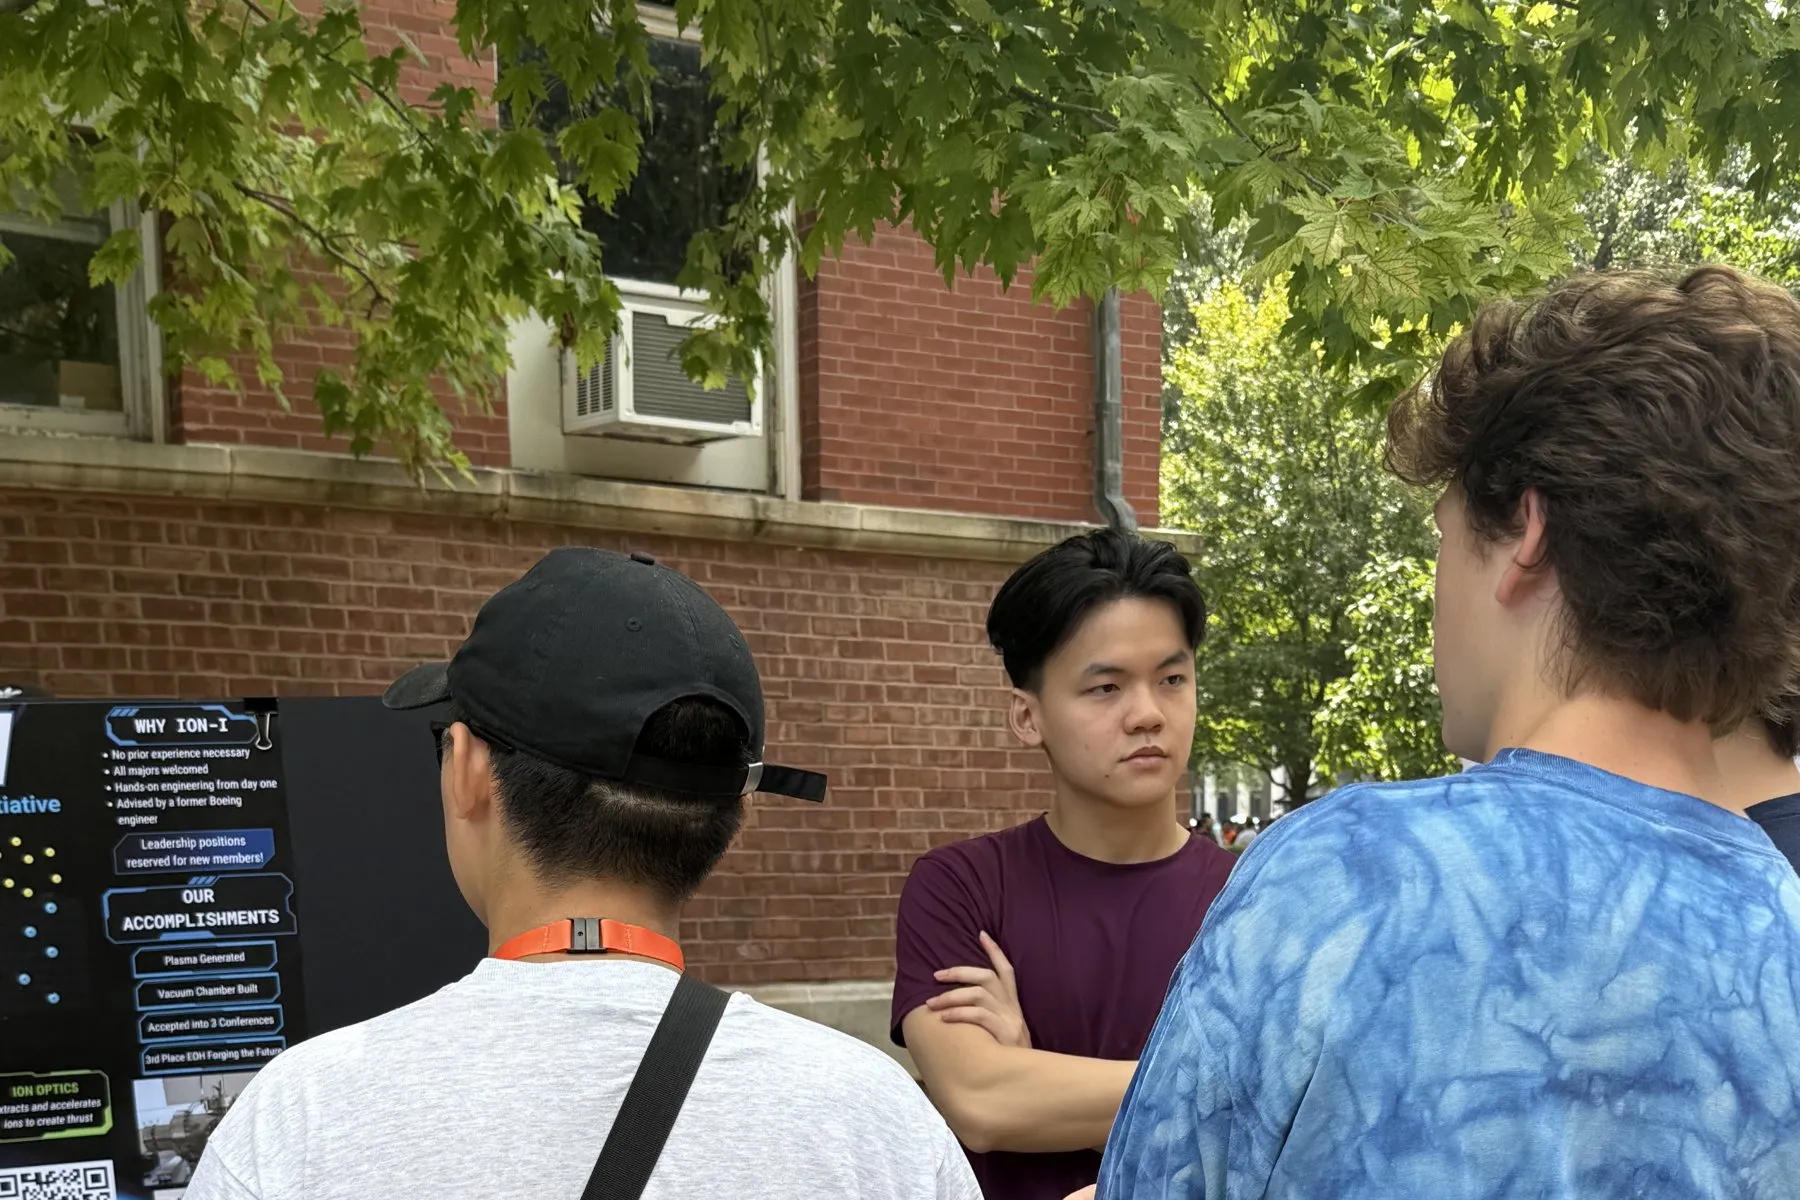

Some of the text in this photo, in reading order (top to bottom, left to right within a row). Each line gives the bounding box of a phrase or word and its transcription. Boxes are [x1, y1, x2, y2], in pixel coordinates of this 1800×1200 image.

[134, 717, 229, 733] WHY ION-I
[112, 748, 251, 762] No prior experience necessary
[113, 764, 209, 778] All majors welcomed
[114, 778, 278, 793] Hands-on engineering from day one
[116, 795, 243, 809] Advised by a former Boeing
[117, 815, 159, 827] engineer
[141, 836, 247, 850] Leadership positions
[126, 852, 264, 868] reserved for new members!
[181, 888, 215, 904] OUR
[122, 909, 280, 931] ACCOMPLISHMENTS
[163, 952, 246, 966] Plasma Generated
[157, 983, 258, 999] Vacuum Chamber Built
[148, 1016, 275, 1033] Accepted into 3 Conferences
[161, 1052, 185, 1063] Place
[207, 1049, 240, 1061] Forging
[240, 1048, 255, 1058] the
[12, 1082, 80, 1097] ION OPTICS
[31, 1100, 49, 1112] and
[50, 1098, 102, 1110] accelerates
[4, 1113, 94, 1129] ions to create thrust
